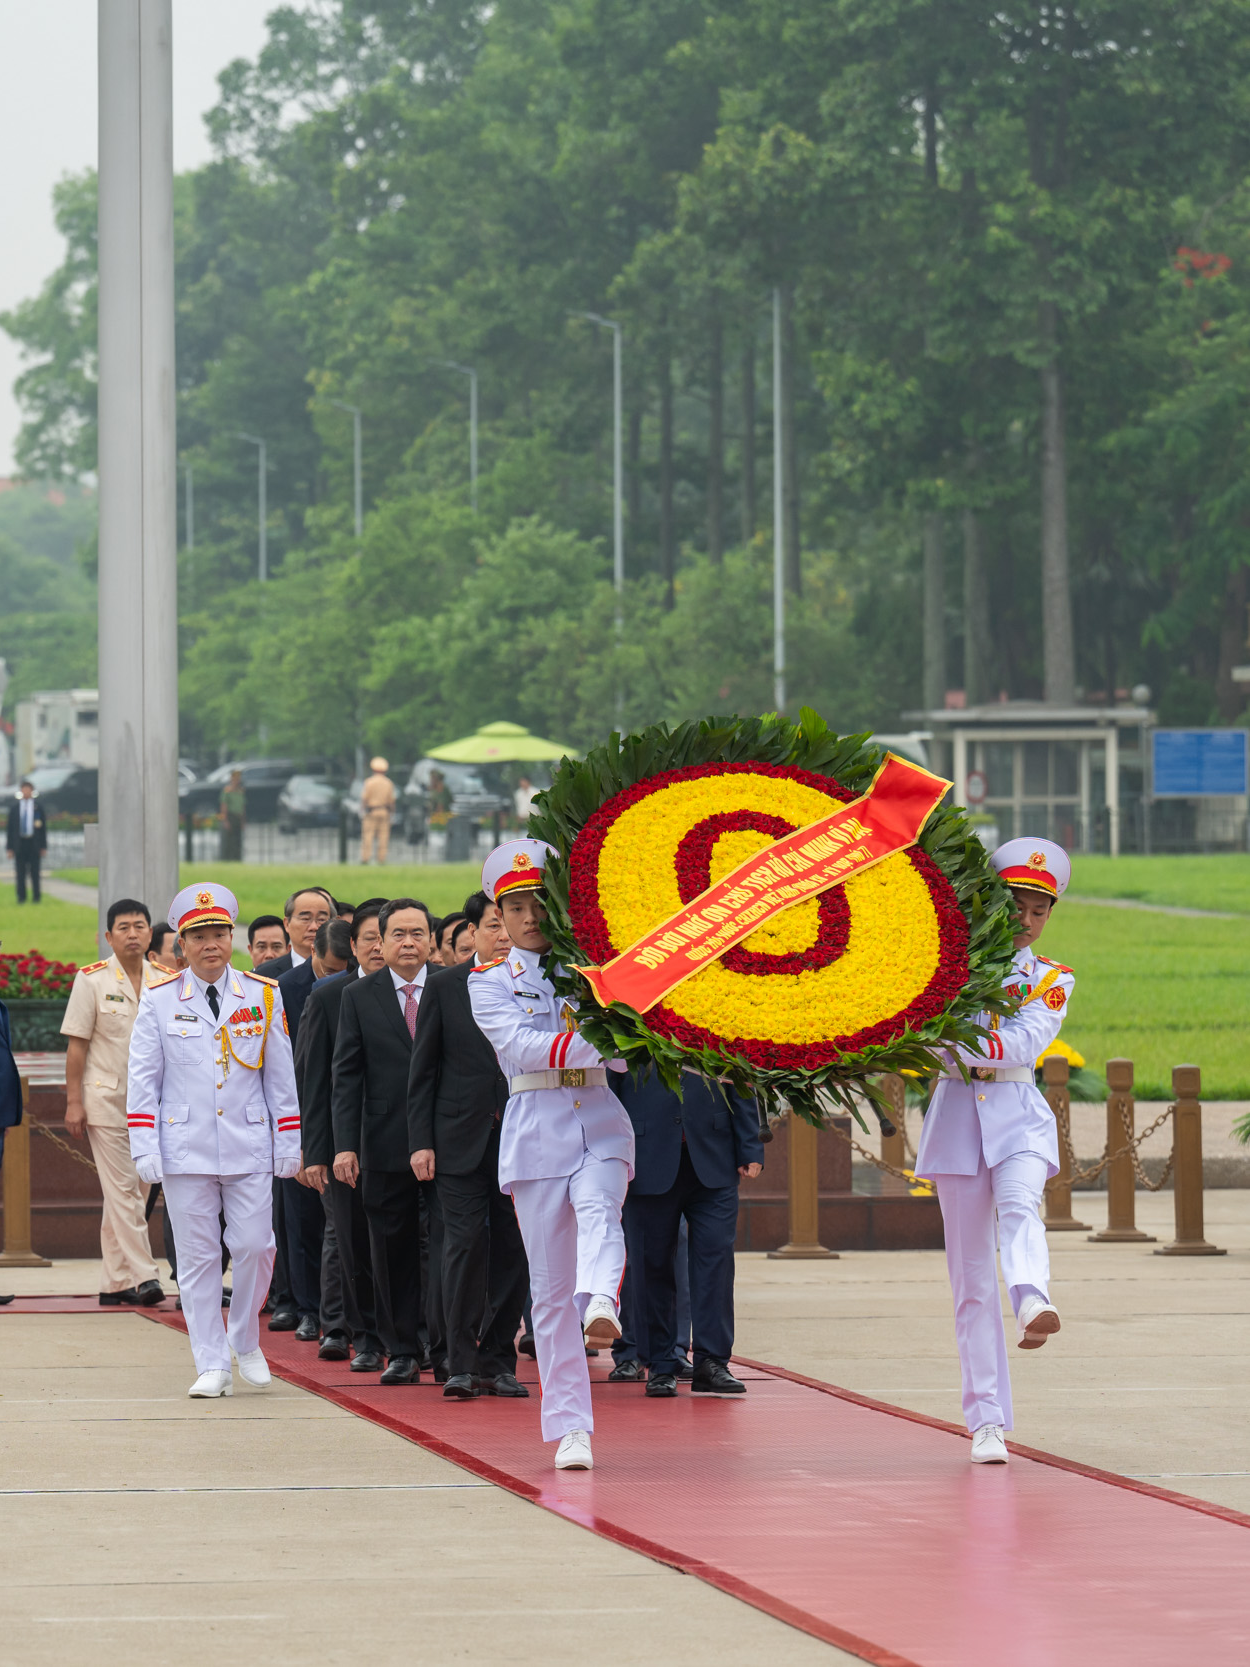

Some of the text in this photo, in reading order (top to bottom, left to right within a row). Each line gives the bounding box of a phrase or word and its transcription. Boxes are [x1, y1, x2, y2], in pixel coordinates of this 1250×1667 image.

[782, 847, 815, 872] CHÍ
[798, 834, 843, 862] MINH
[765, 852, 795, 878] HỒ
[740, 866, 781, 892] TỊCH
[718, 883, 755, 909] CHỦ
[675, 913, 714, 939] NHỚ
[701, 904, 733, 922] ƠN
